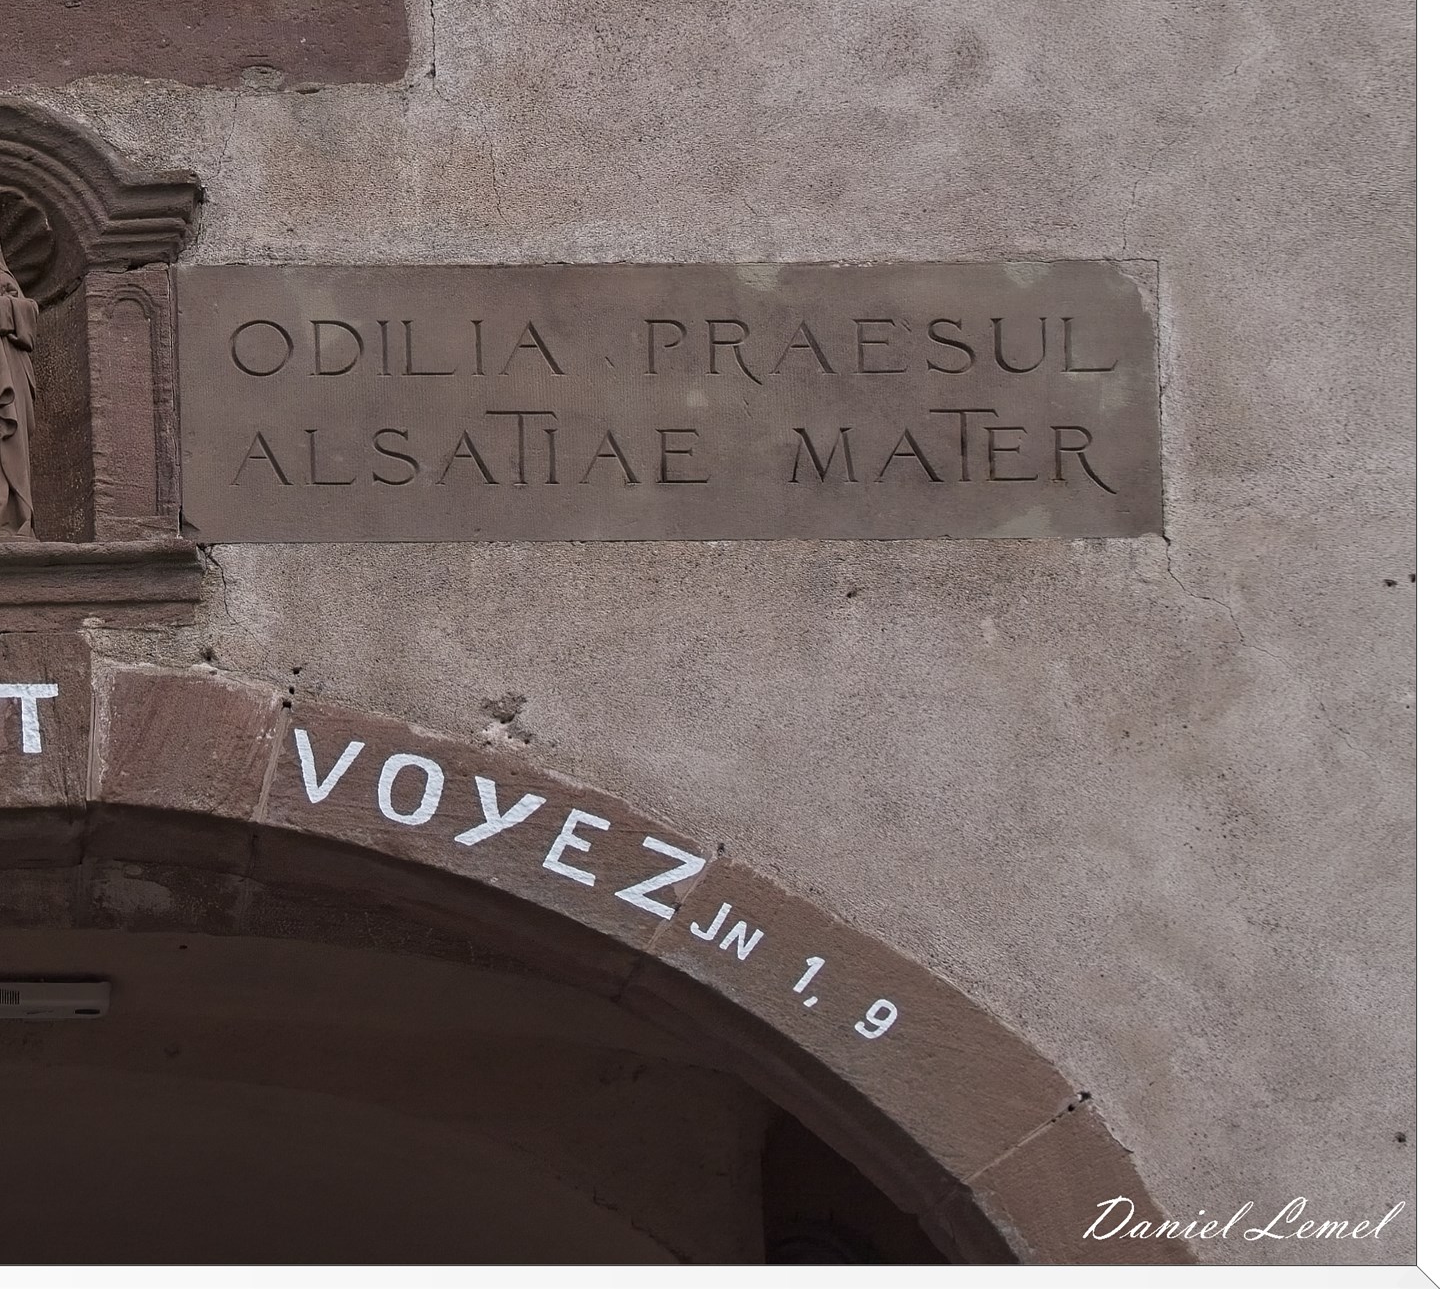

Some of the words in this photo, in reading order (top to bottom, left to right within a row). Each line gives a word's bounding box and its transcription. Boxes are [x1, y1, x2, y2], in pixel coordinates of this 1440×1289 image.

[229, 319, 565, 377] ODILIA
[644, 317, 1119, 385] PRAESUL
[229, 410, 712, 486] ALSATIAE
[788, 408, 1118, 495] MATER
[294, 728, 706, 920] VOYEZ
[690, 902, 764, 960] JN
[793, 956, 825, 1007] 1,
[854, 999, 898, 1039] 9
